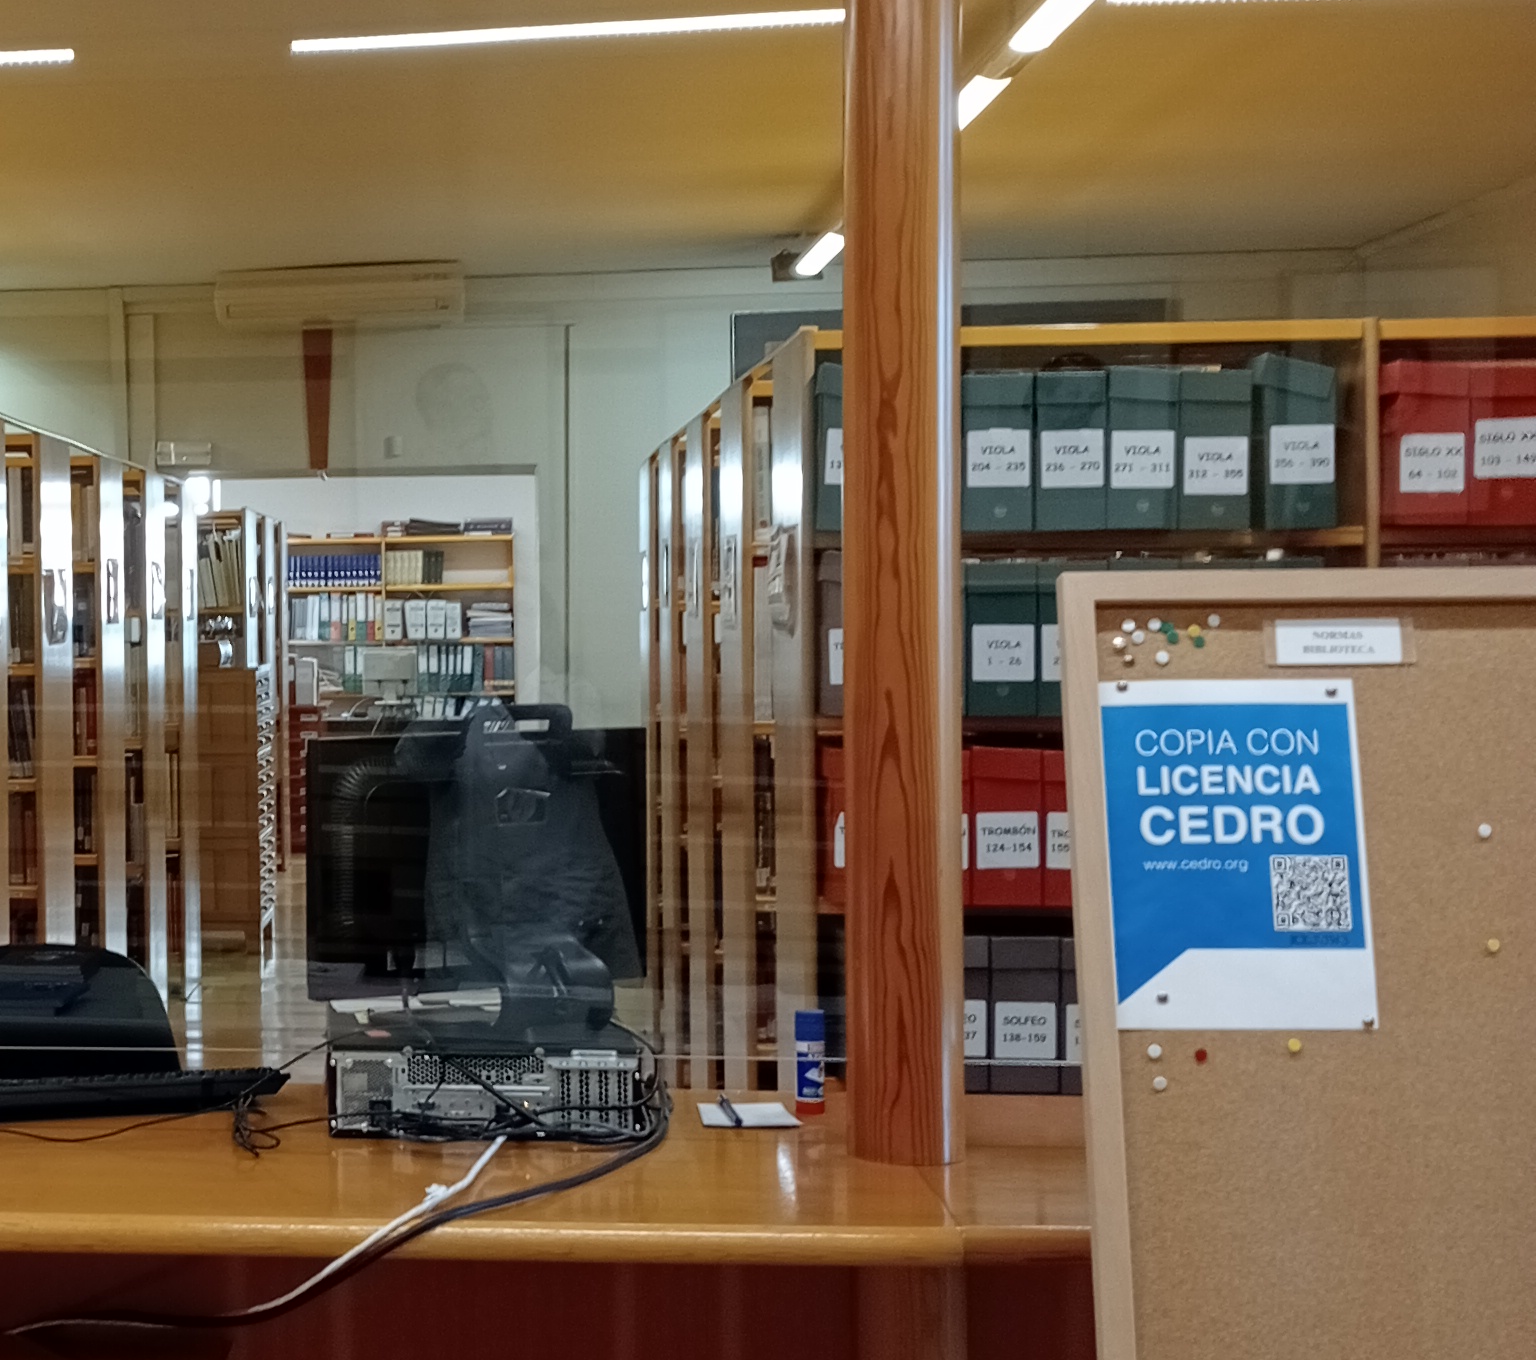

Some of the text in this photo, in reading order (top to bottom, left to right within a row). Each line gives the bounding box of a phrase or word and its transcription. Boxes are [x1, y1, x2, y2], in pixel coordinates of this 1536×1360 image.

[981, 446, 1015, 455] VIOLA
[1055, 446, 1088, 454] VIOLA
[1125, 446, 1160, 455] VIOLA
[1284, 441, 1319, 451] VIOLA
[1198, 453, 1232, 461] VIOLA
[1080, 461, 1100, 470] 270
[988, 640, 1021, 649] VIOLA
[1135, 728, 1319, 756] COPIA CON
[1137, 764, 1320, 795] LICENCIA
[980, 822, 1036, 835] TROMBÓN
[1140, 805, 1324, 845] CEDRO
[1143, 858, 1248, 872] www.cedro.org
[1004, 1016, 1046, 1025] SOLFEO
